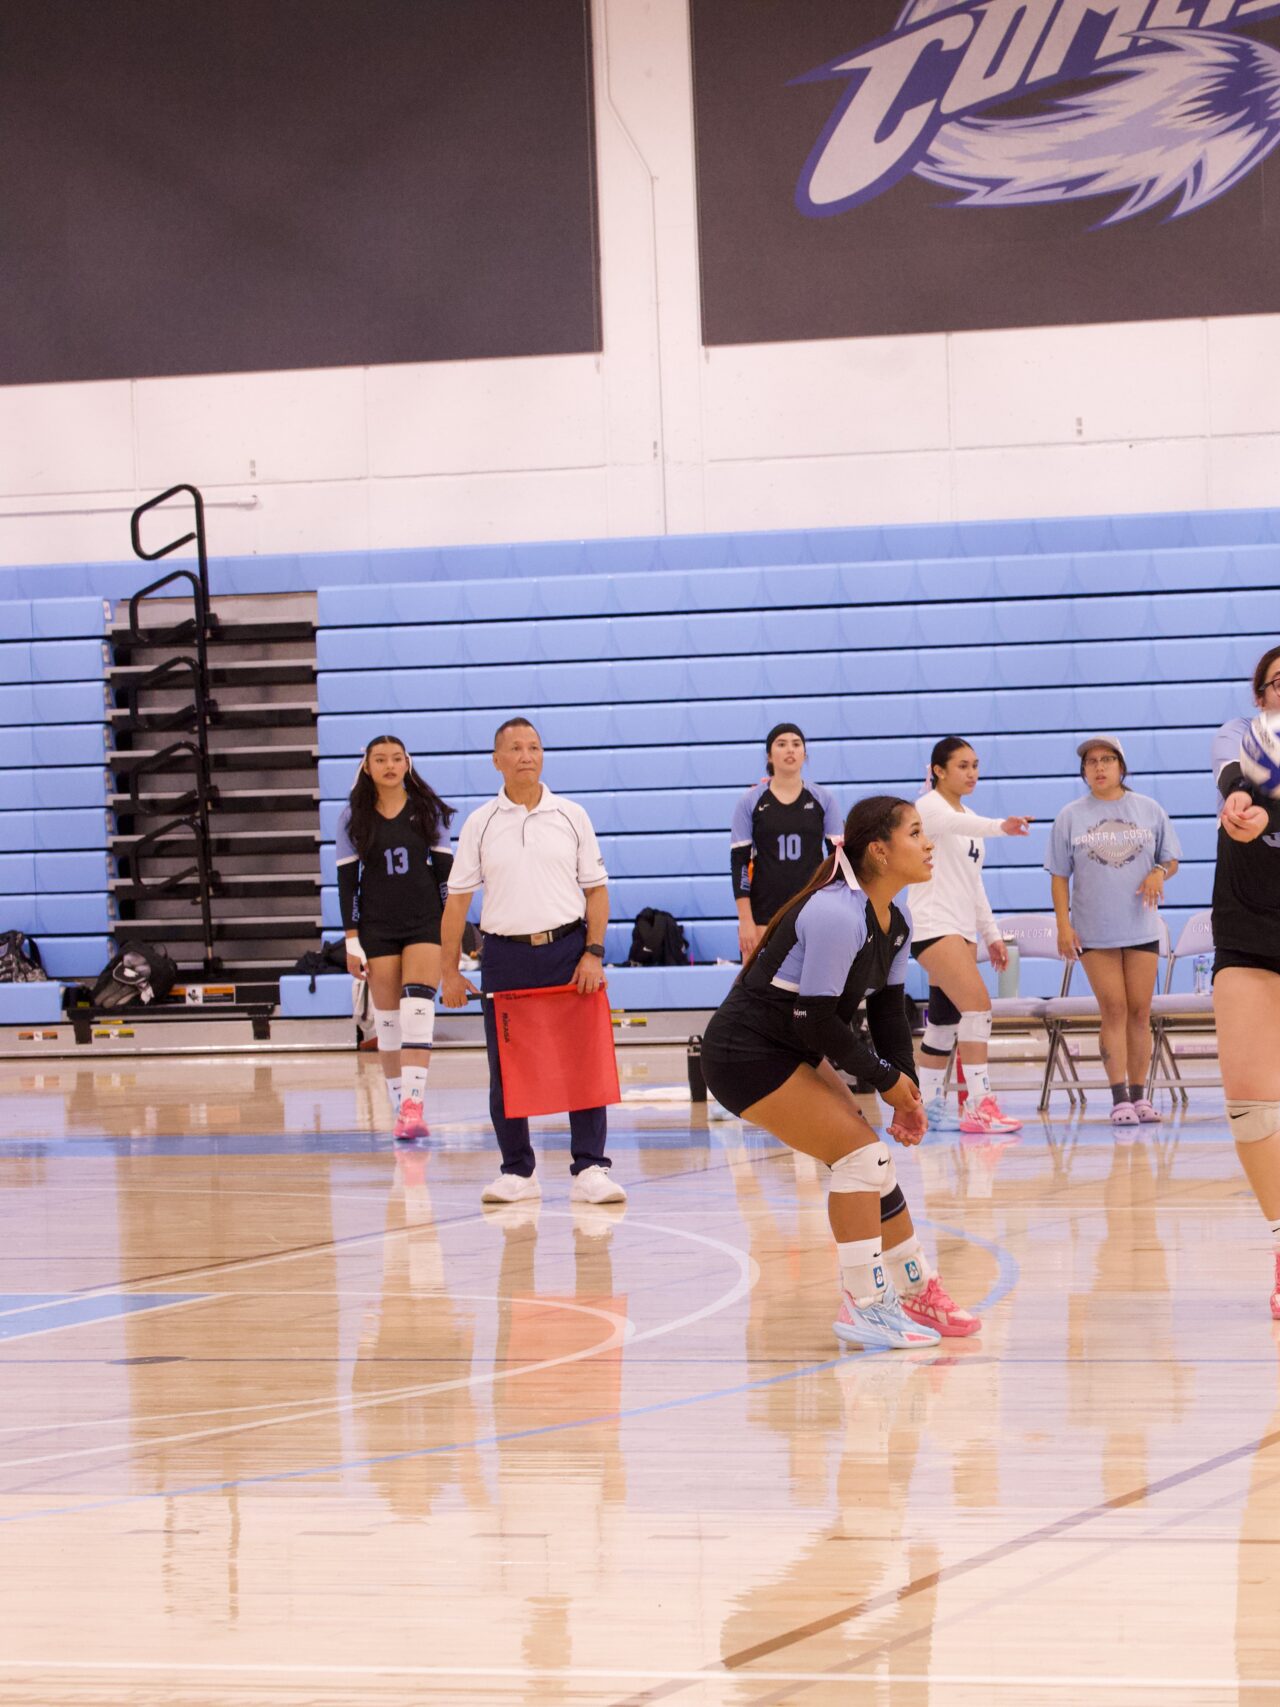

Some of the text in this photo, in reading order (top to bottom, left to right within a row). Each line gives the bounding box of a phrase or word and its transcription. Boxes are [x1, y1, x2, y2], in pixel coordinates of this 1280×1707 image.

[777, 833, 802, 861] 10
[1074, 828, 1153, 845] CONTRA COSTA
[383, 846, 409, 875] 13
[968, 839, 980, 864] 4
